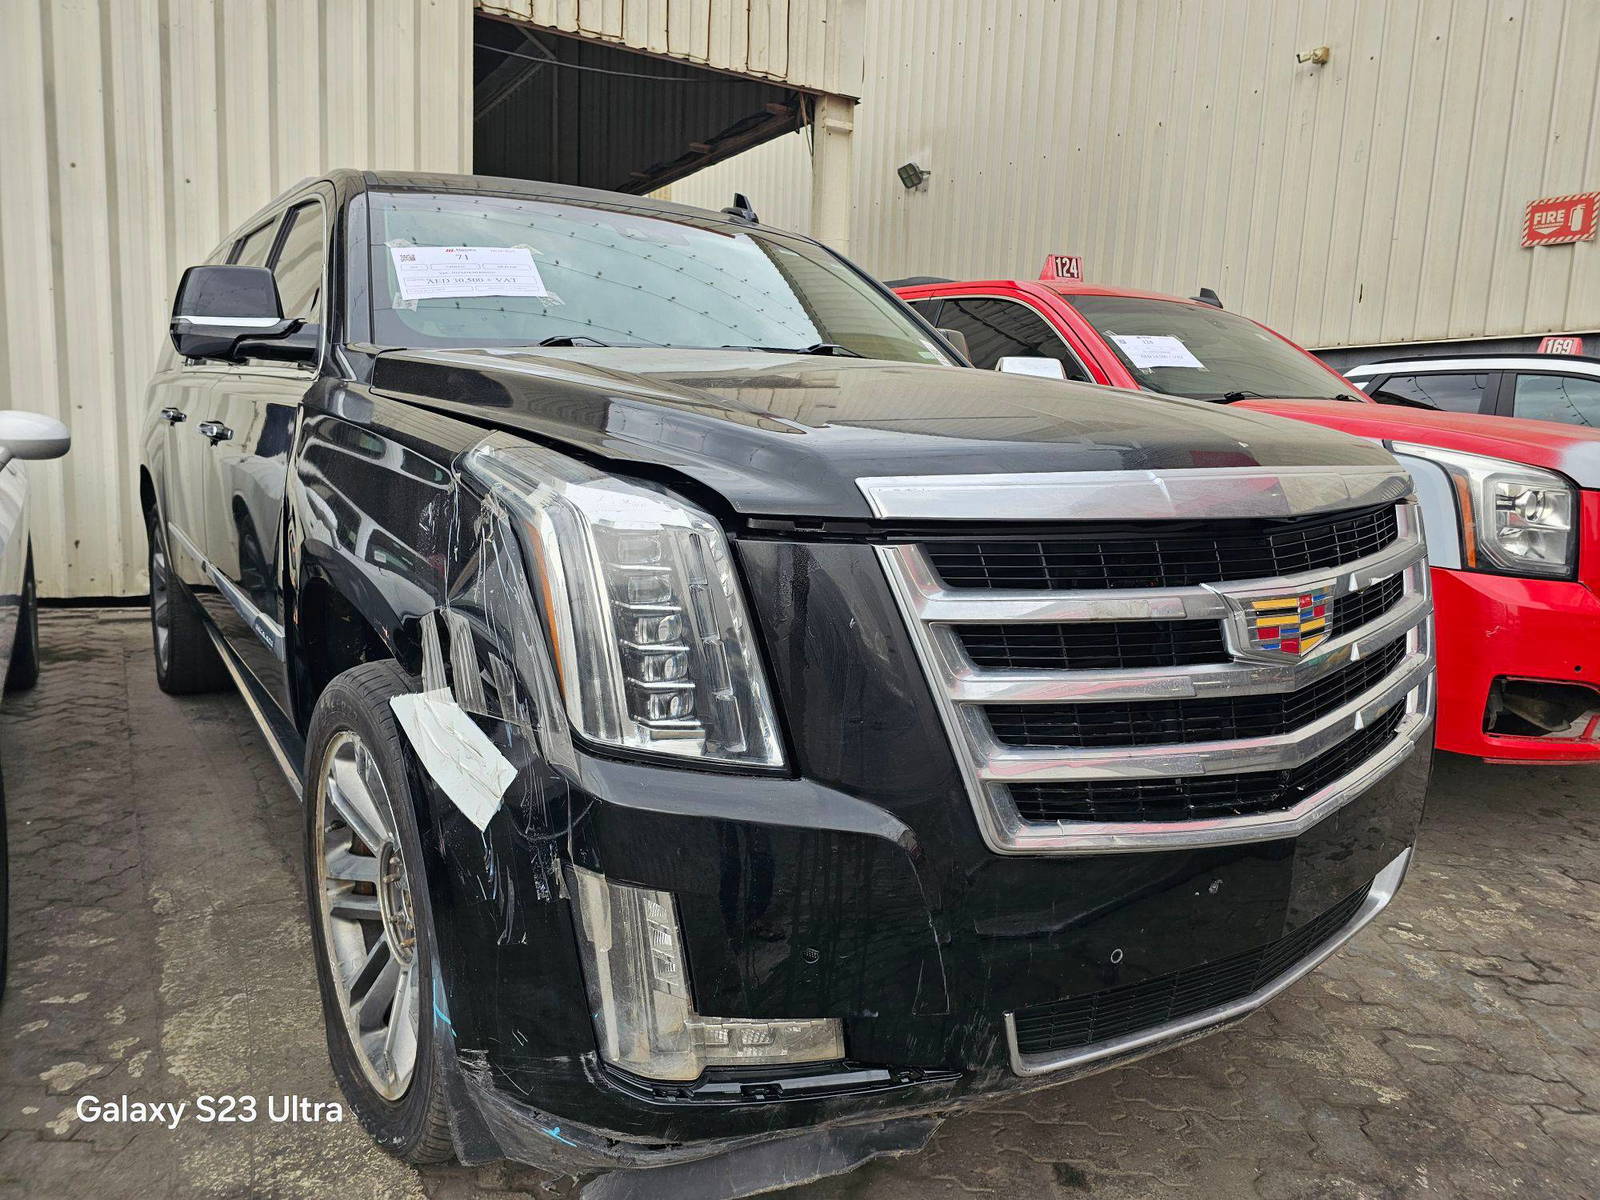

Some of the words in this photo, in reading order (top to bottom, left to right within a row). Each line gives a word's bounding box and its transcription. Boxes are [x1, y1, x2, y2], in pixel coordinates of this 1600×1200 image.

[1533, 209, 1566, 225] FIRE
[1055, 257, 1078, 278] 124
[1546, 339, 1573, 355] 169
